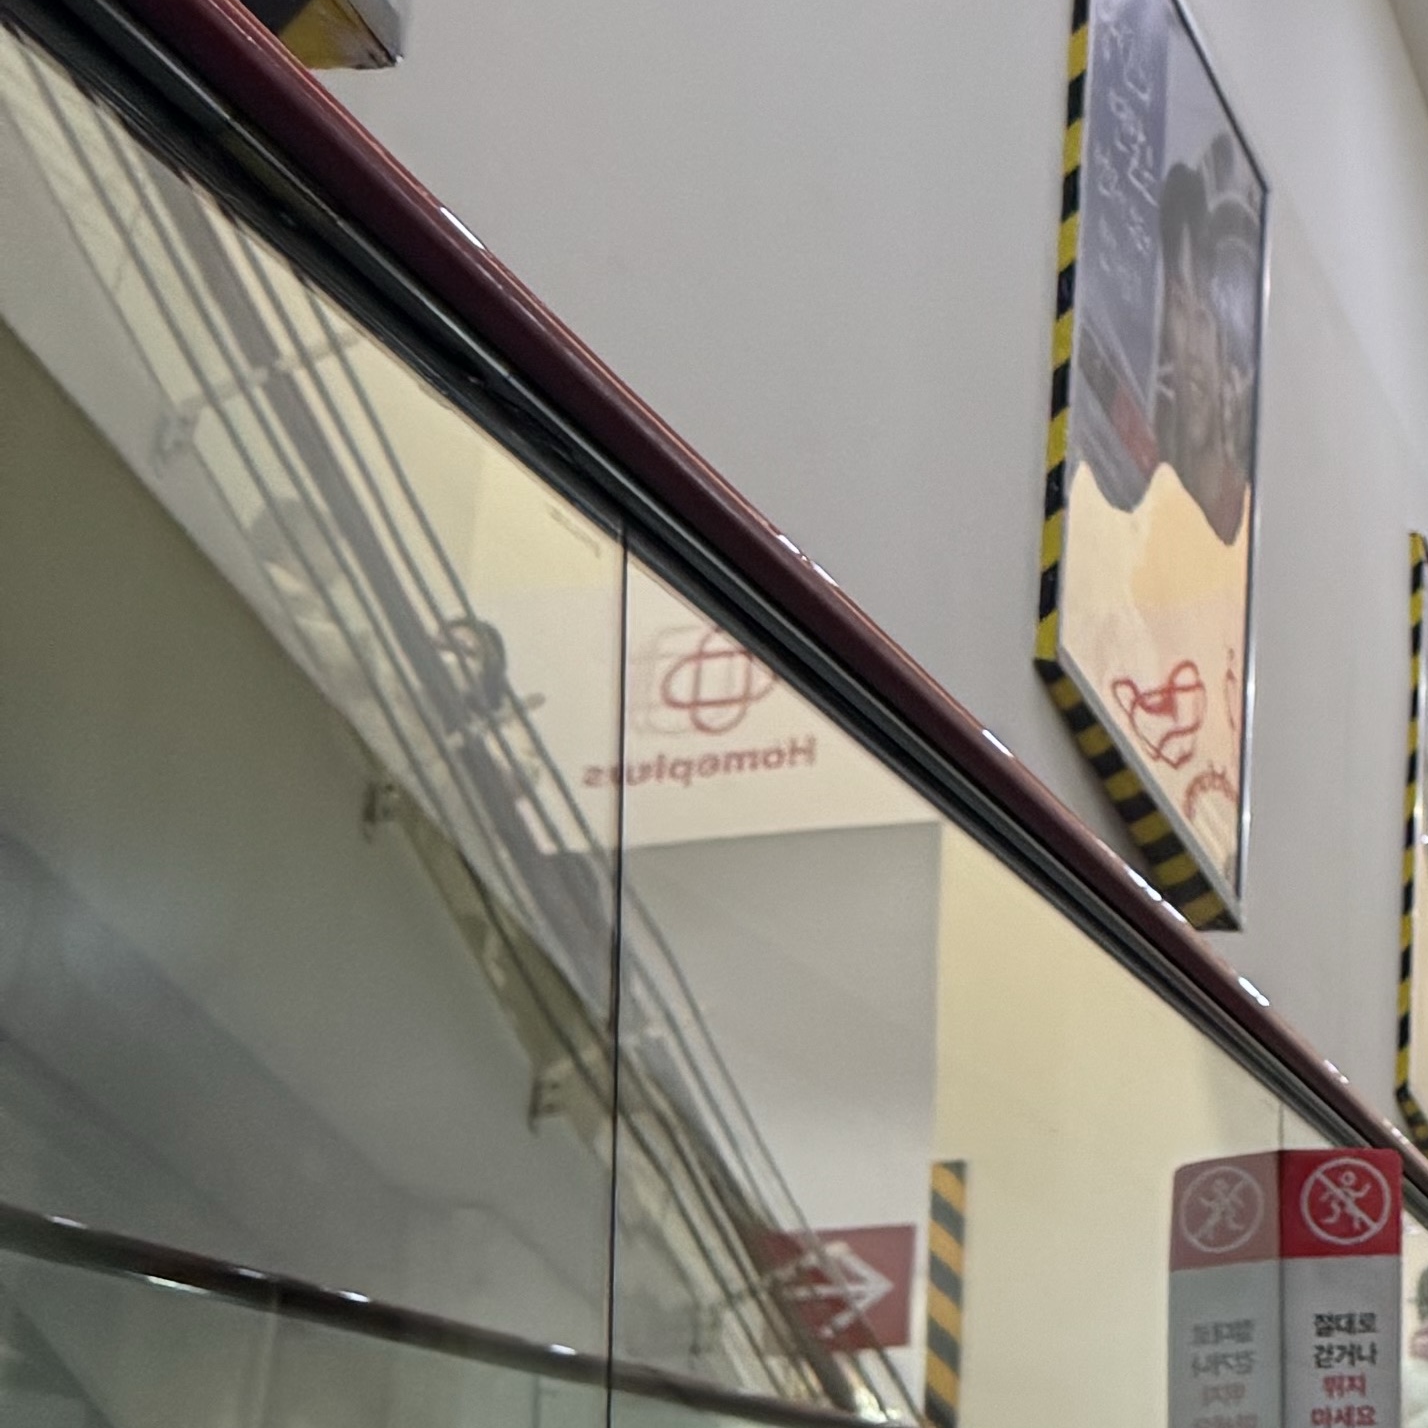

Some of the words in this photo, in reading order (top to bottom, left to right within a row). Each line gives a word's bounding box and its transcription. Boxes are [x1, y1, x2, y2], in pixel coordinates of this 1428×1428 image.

[1313, 1312, 1378, 1337] 절대로
[1313, 1341, 1378, 1369] 걷거나
[1322, 1372, 1367, 1399] 뛰지
[1310, 1405, 1377, 1428] 마세요
